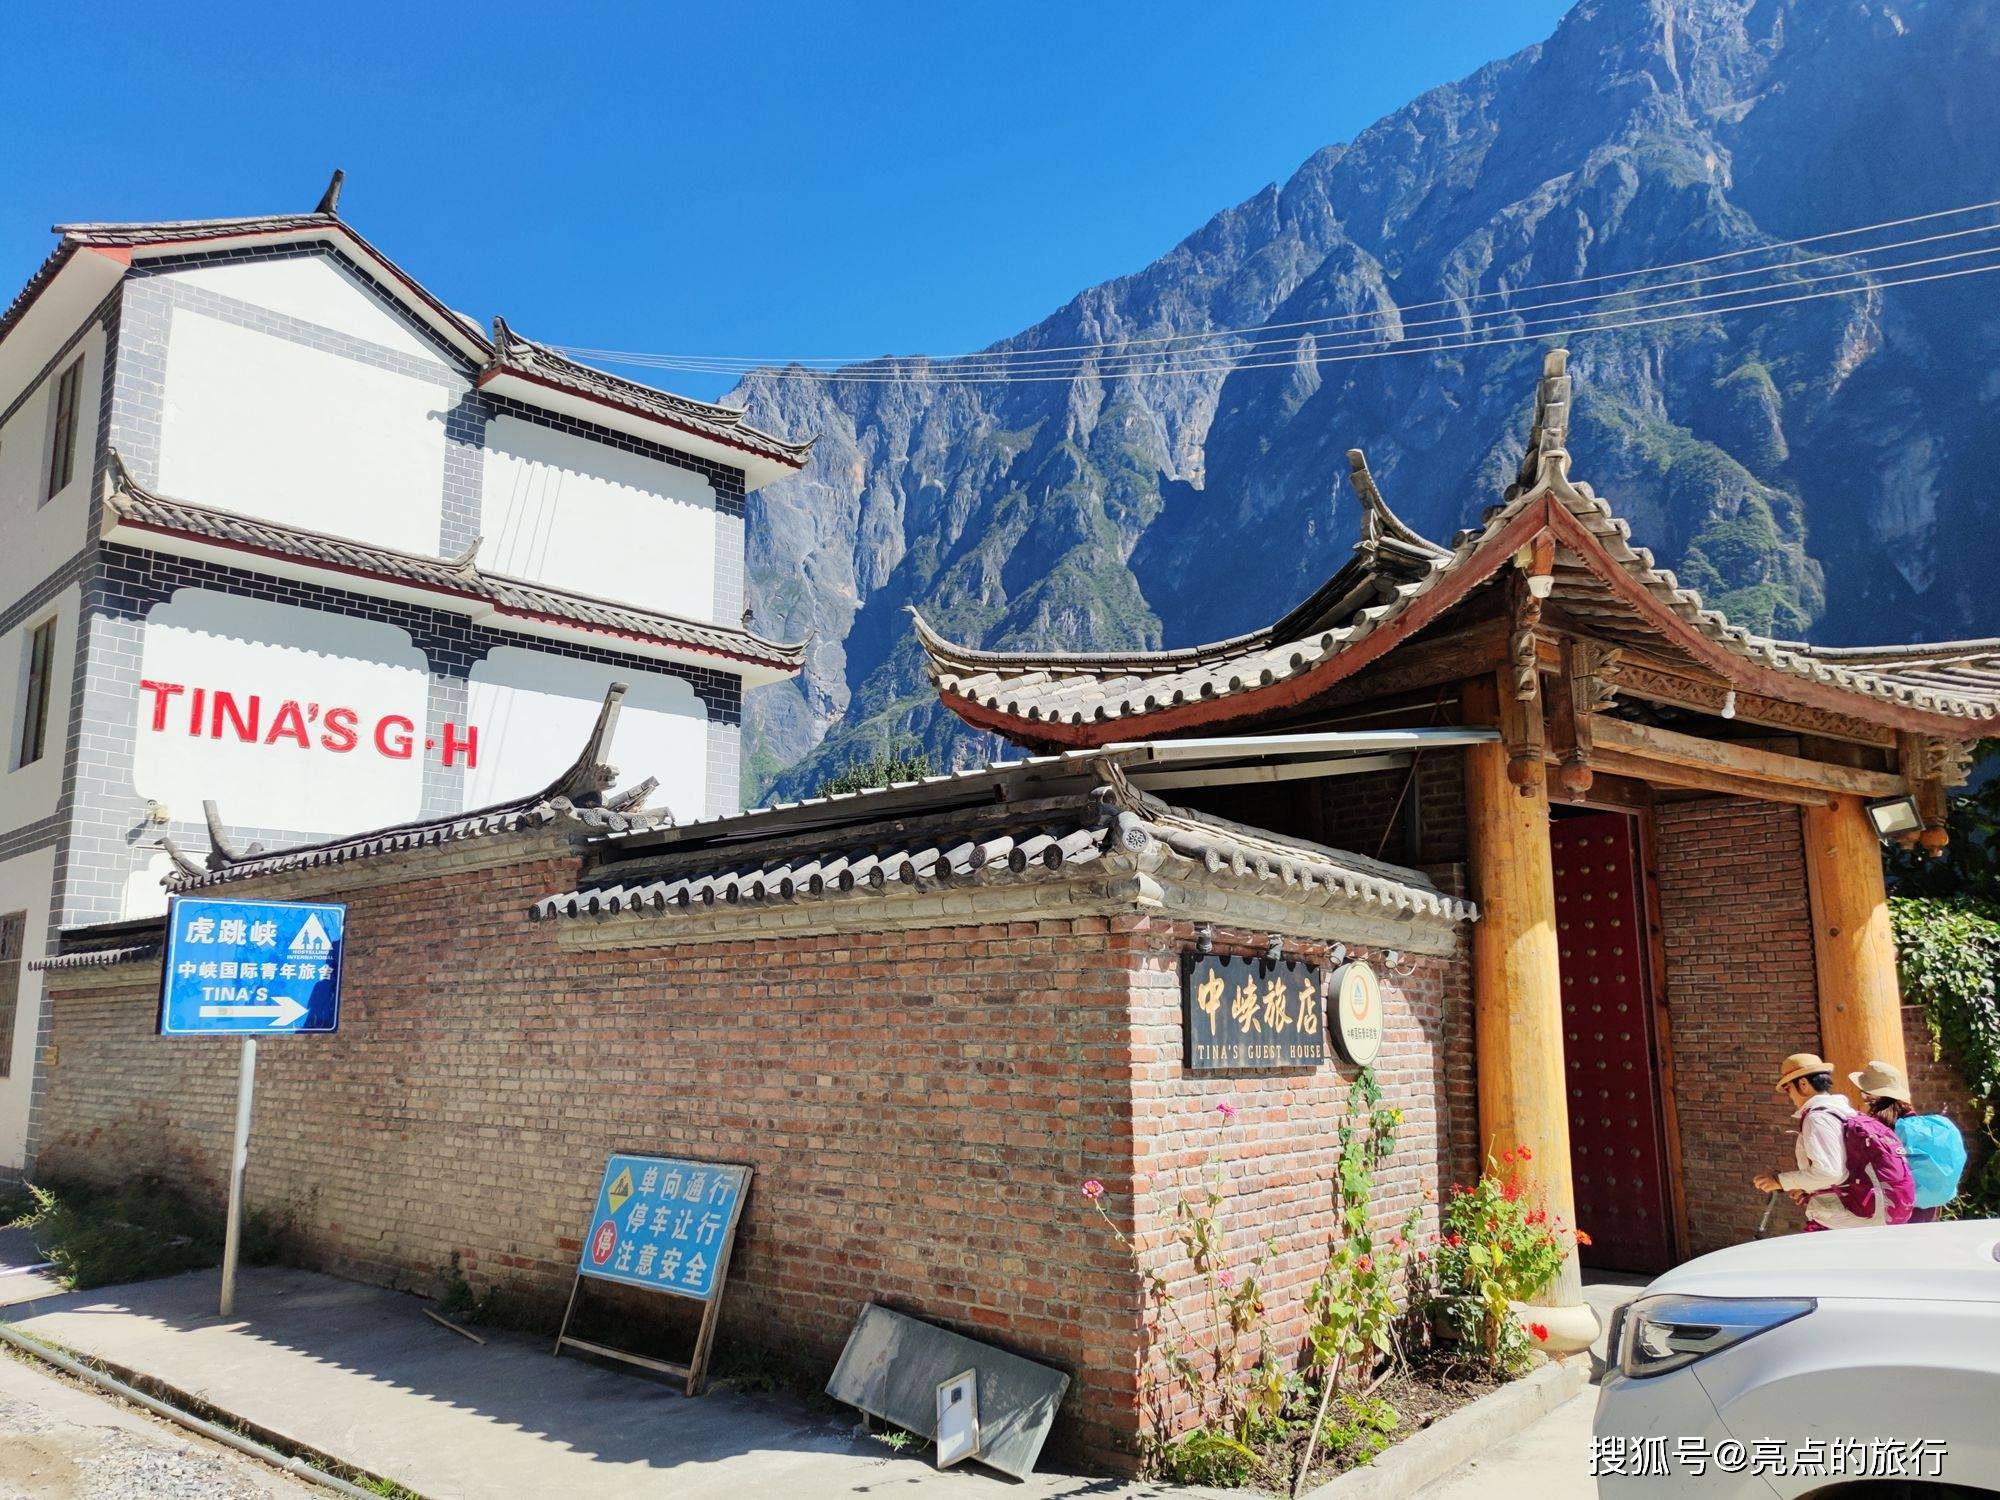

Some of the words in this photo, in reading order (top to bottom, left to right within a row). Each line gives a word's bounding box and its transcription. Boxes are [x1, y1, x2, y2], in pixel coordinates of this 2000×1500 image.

[140, 679, 359, 753] TINA'S
[185, 916, 278, 947] 虎跳峡
[178, 960, 334, 981] 中峡国际青年旅舍
[1198, 1044, 1239, 1060] TINA'S
[1247, 1045, 1283, 1060] GUEST
[1290, 1044, 1321, 1059] HOUSE
[638, 1166, 734, 1206] 单向通行
[625, 1202, 722, 1246] 停车让行
[595, 1228, 614, 1258] 停
[614, 1240, 707, 1286] 注意安全
